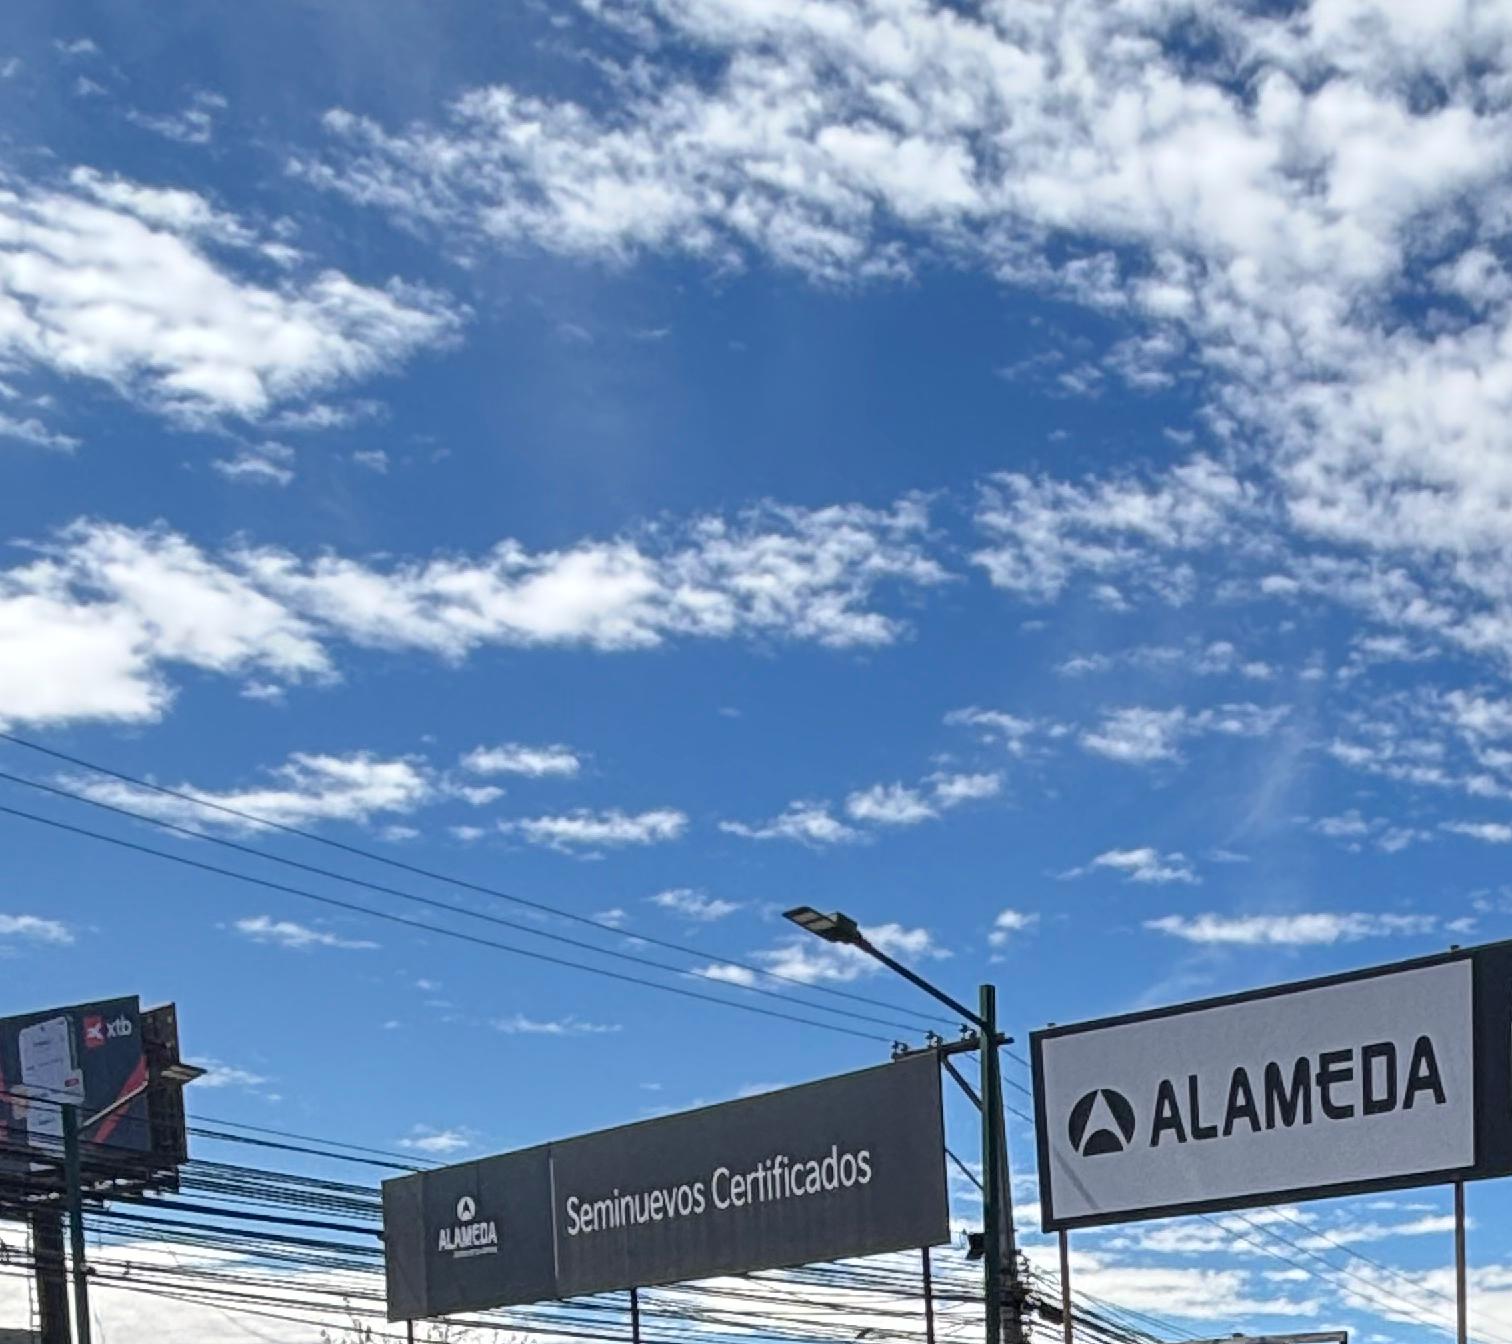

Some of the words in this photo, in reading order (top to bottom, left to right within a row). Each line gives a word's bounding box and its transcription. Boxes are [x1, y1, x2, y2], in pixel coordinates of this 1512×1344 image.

[107, 1015, 133, 1038] xtb
[1149, 1035, 1447, 1148] ALAMEDA
[566, 1182, 705, 1236] Seminuevos
[711, 1145, 872, 1210] Certificados
[439, 1221, 497, 1251] ALAMEDA
